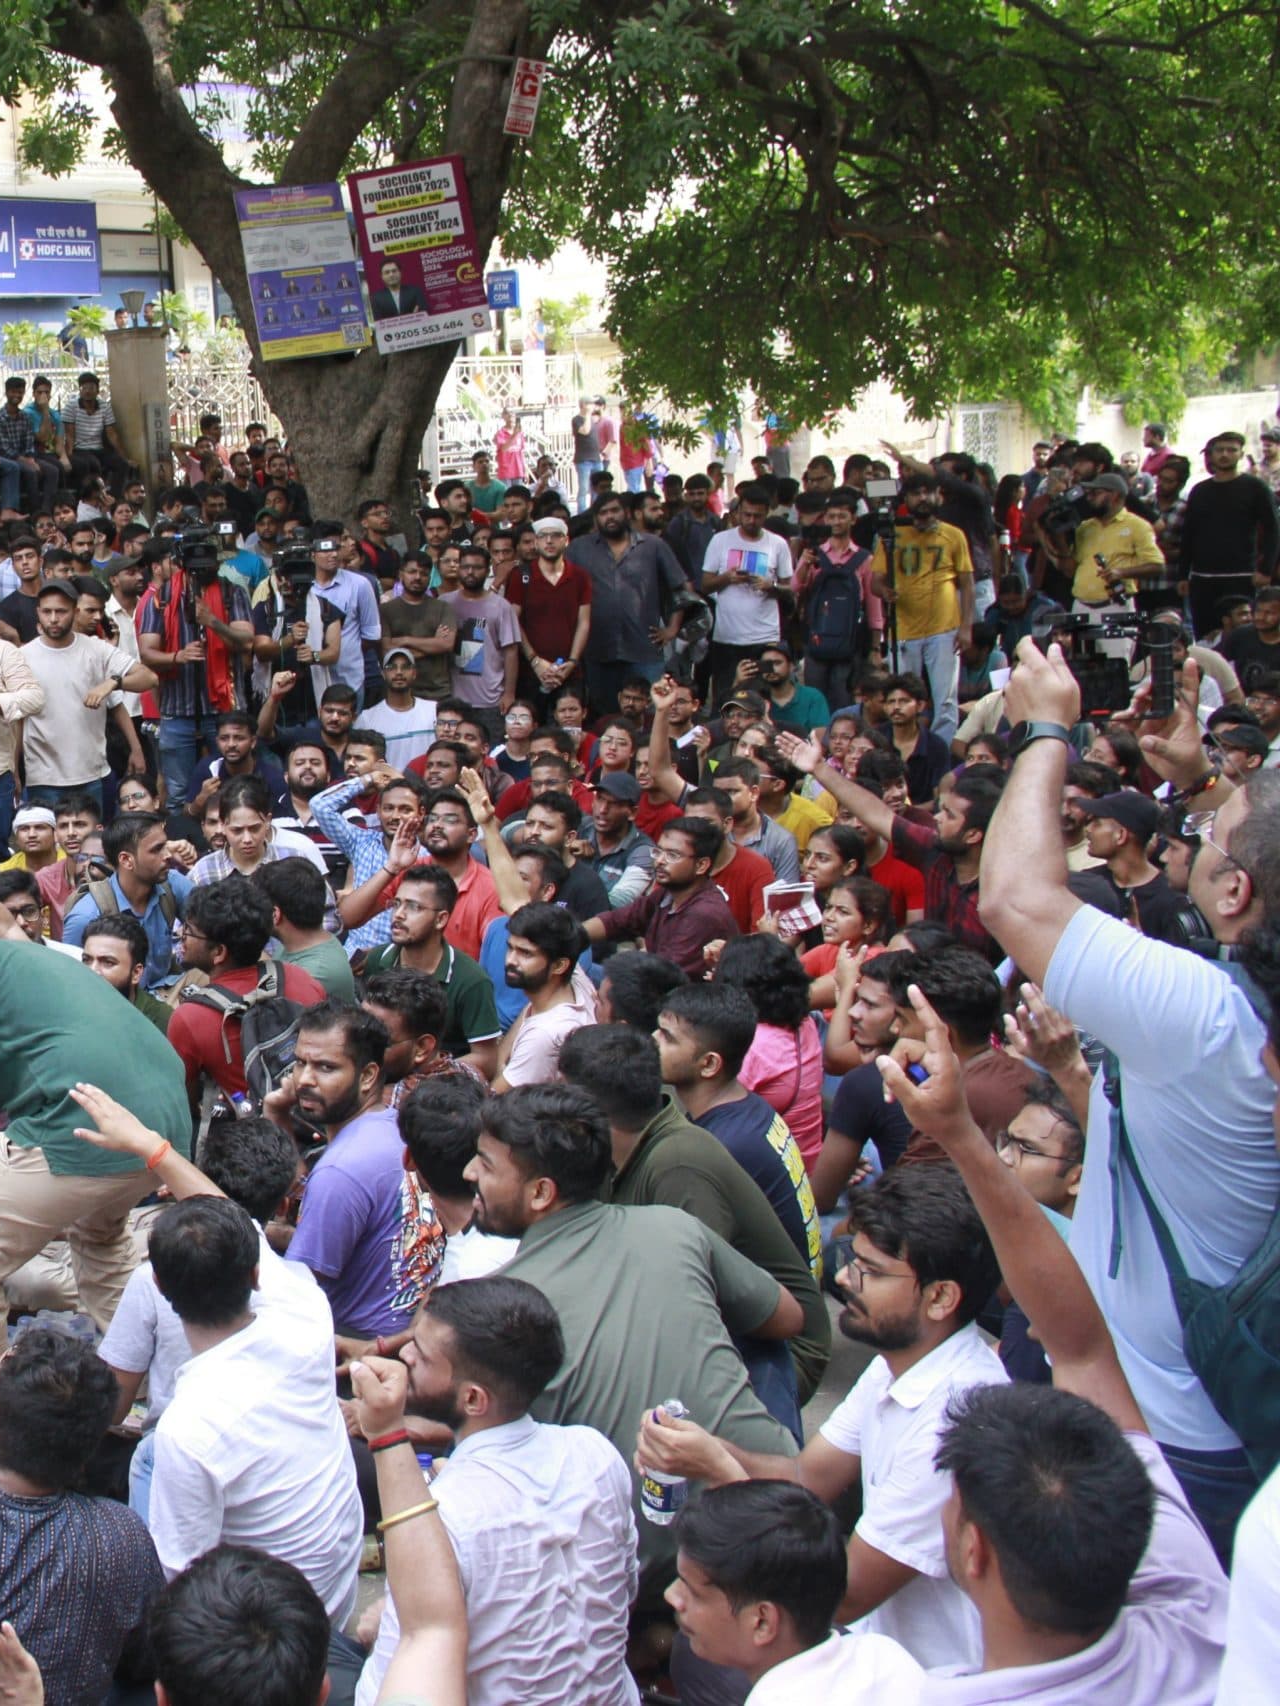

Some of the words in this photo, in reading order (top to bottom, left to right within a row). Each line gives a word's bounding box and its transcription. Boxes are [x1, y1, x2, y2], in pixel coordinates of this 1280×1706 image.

[378, 170, 433, 189] SOCIOLOGY
[363, 183, 423, 204] FOUNDATION
[424, 178, 450, 192] 2025
[386, 209, 440, 229] SOCIOLOGY
[372, 223, 432, 243] ENRICHMENT
[434, 217, 460, 231] 2024
[37, 244, 63, 256] HDFC
[64, 245, 91, 257] BANK
[420, 244, 466, 260] SOCIOLOGY
[421, 250, 473, 266] ENRICHMENT
[394, 328, 420, 340] 9205
[422, 323, 440, 334] 553
[442, 318, 464, 330] 484
